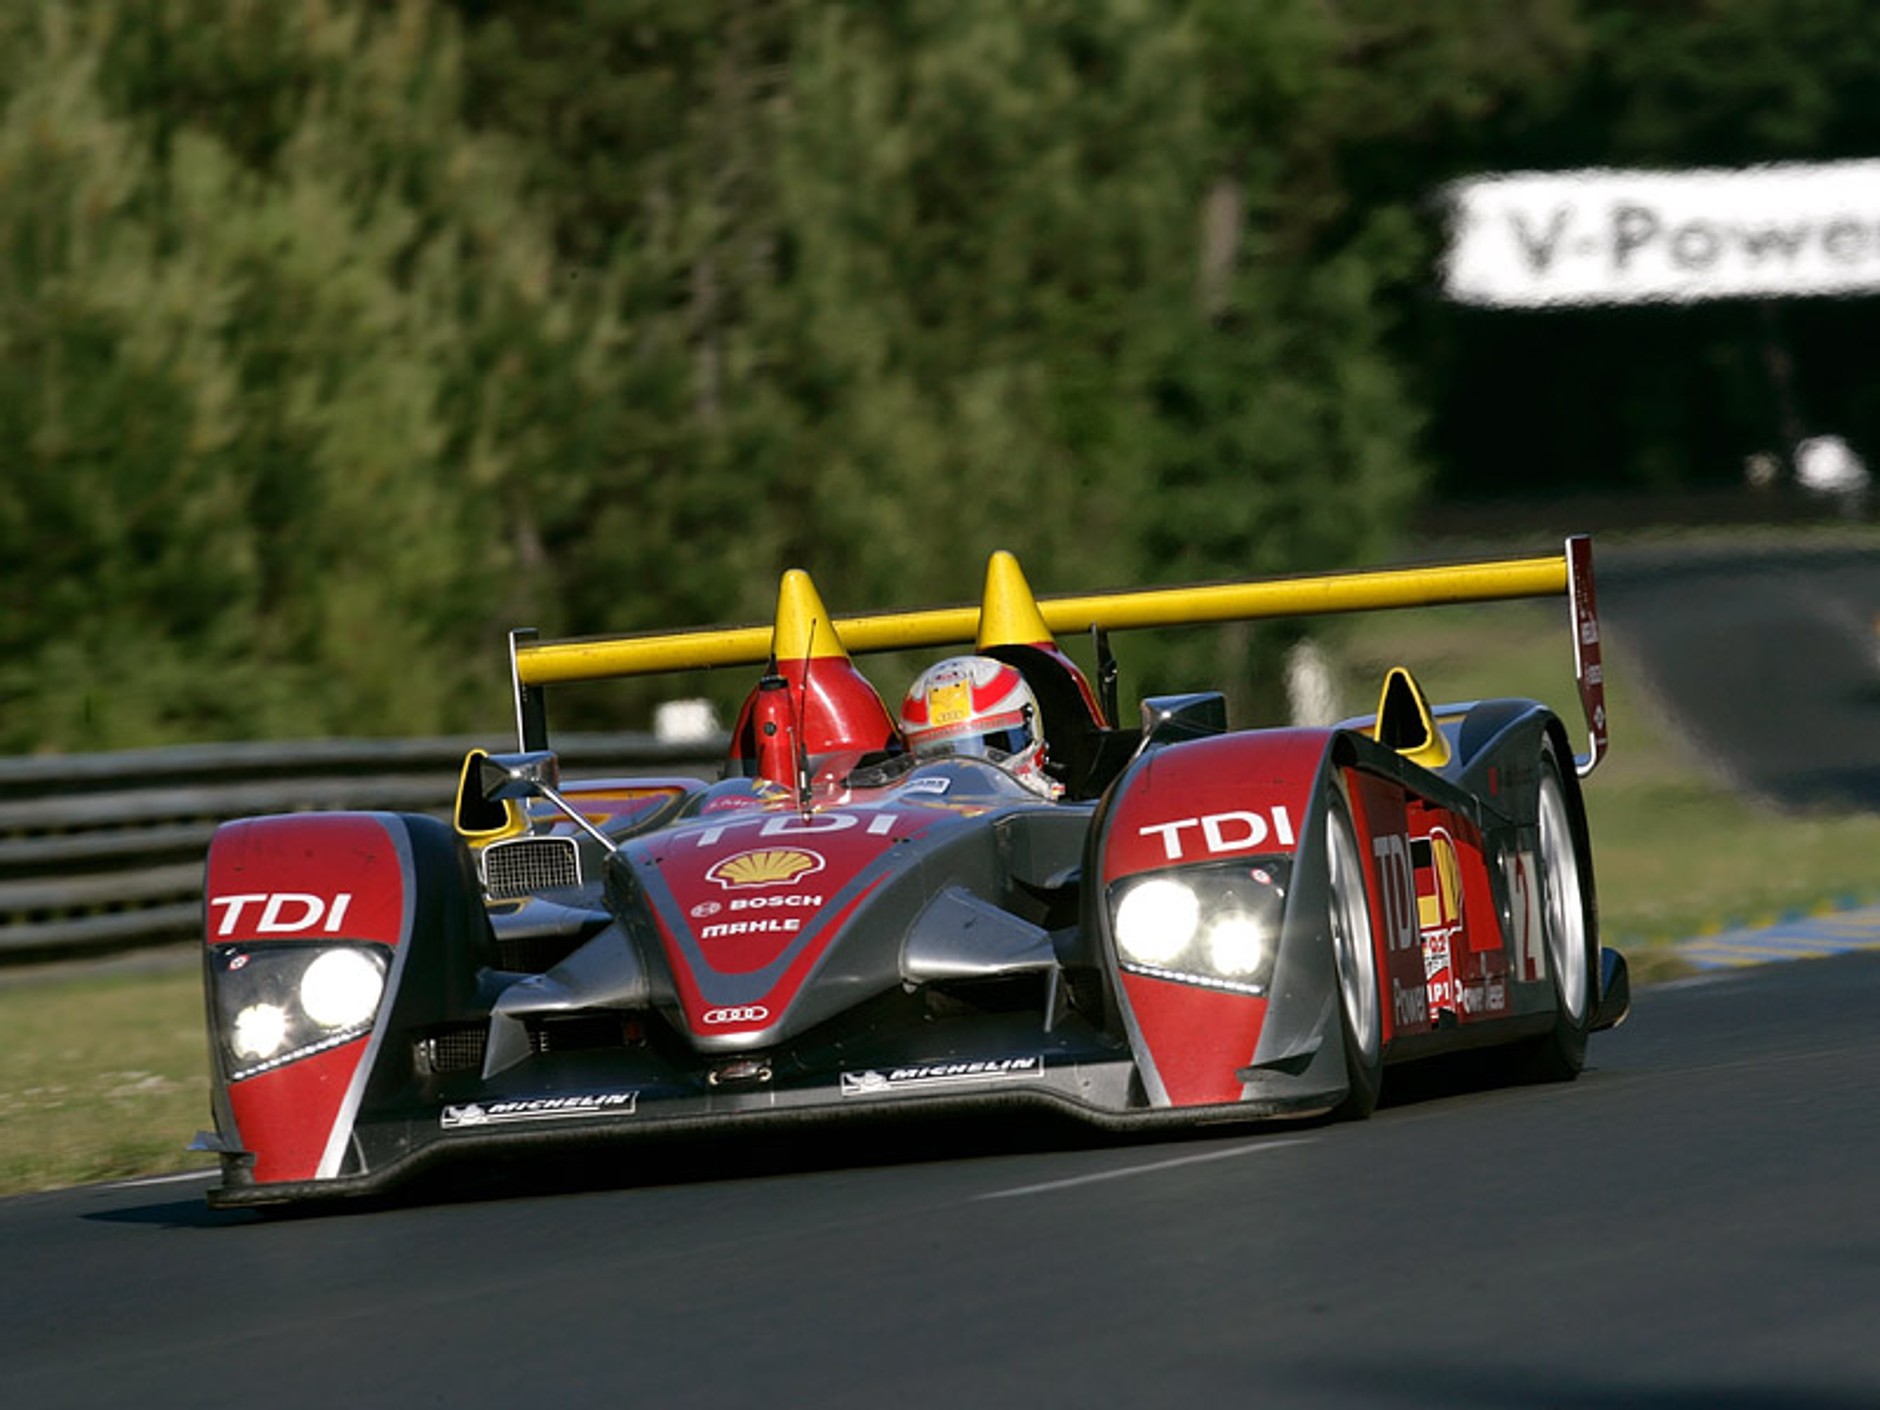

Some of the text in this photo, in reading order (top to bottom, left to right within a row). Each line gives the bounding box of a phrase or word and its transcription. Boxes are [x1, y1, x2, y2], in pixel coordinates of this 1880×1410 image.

[1502, 202, 1880, 276] V-Powe
[672, 813, 899, 847] TDI
[1138, 805, 1295, 860] TDI
[210, 893, 352, 936] TDI
[729, 894, 823, 911] BOSCH
[701, 918, 800, 939] MAHLE
[888, 1057, 1036, 1080] MICHELIN
[488, 1091, 630, 1114] MICHELIN
